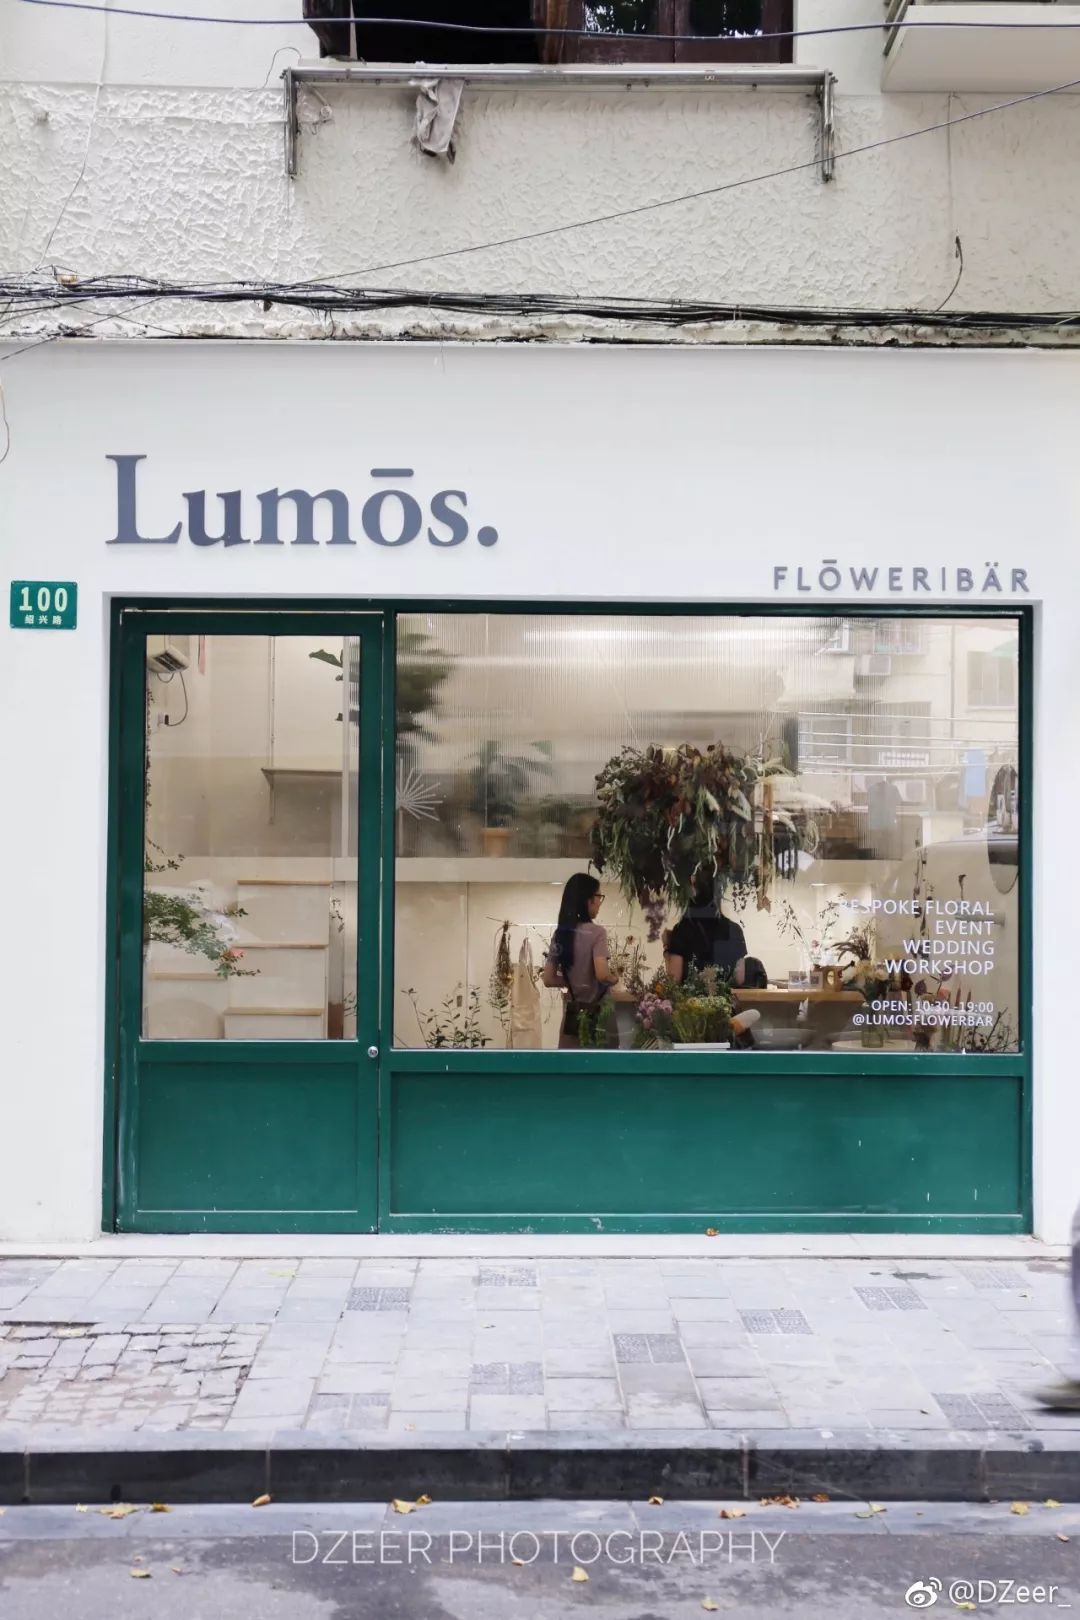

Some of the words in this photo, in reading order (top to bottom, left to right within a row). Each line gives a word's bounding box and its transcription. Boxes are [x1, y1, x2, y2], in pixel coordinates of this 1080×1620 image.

[105, 454, 499, 547] Lumōs.
[19, 586, 68, 612] 100
[926, 900, 994, 916] FLORAL
[935, 920, 994, 936] EVENT
[903, 939, 995, 955] WEDDING
[884, 958, 994, 976] WORKSHOP
[871, 1000, 912, 1012] OPEN:
[915, 1001, 950, 1012] 10:30
[852, 1014, 994, 1027] @LUMOSFLOWERBAR
